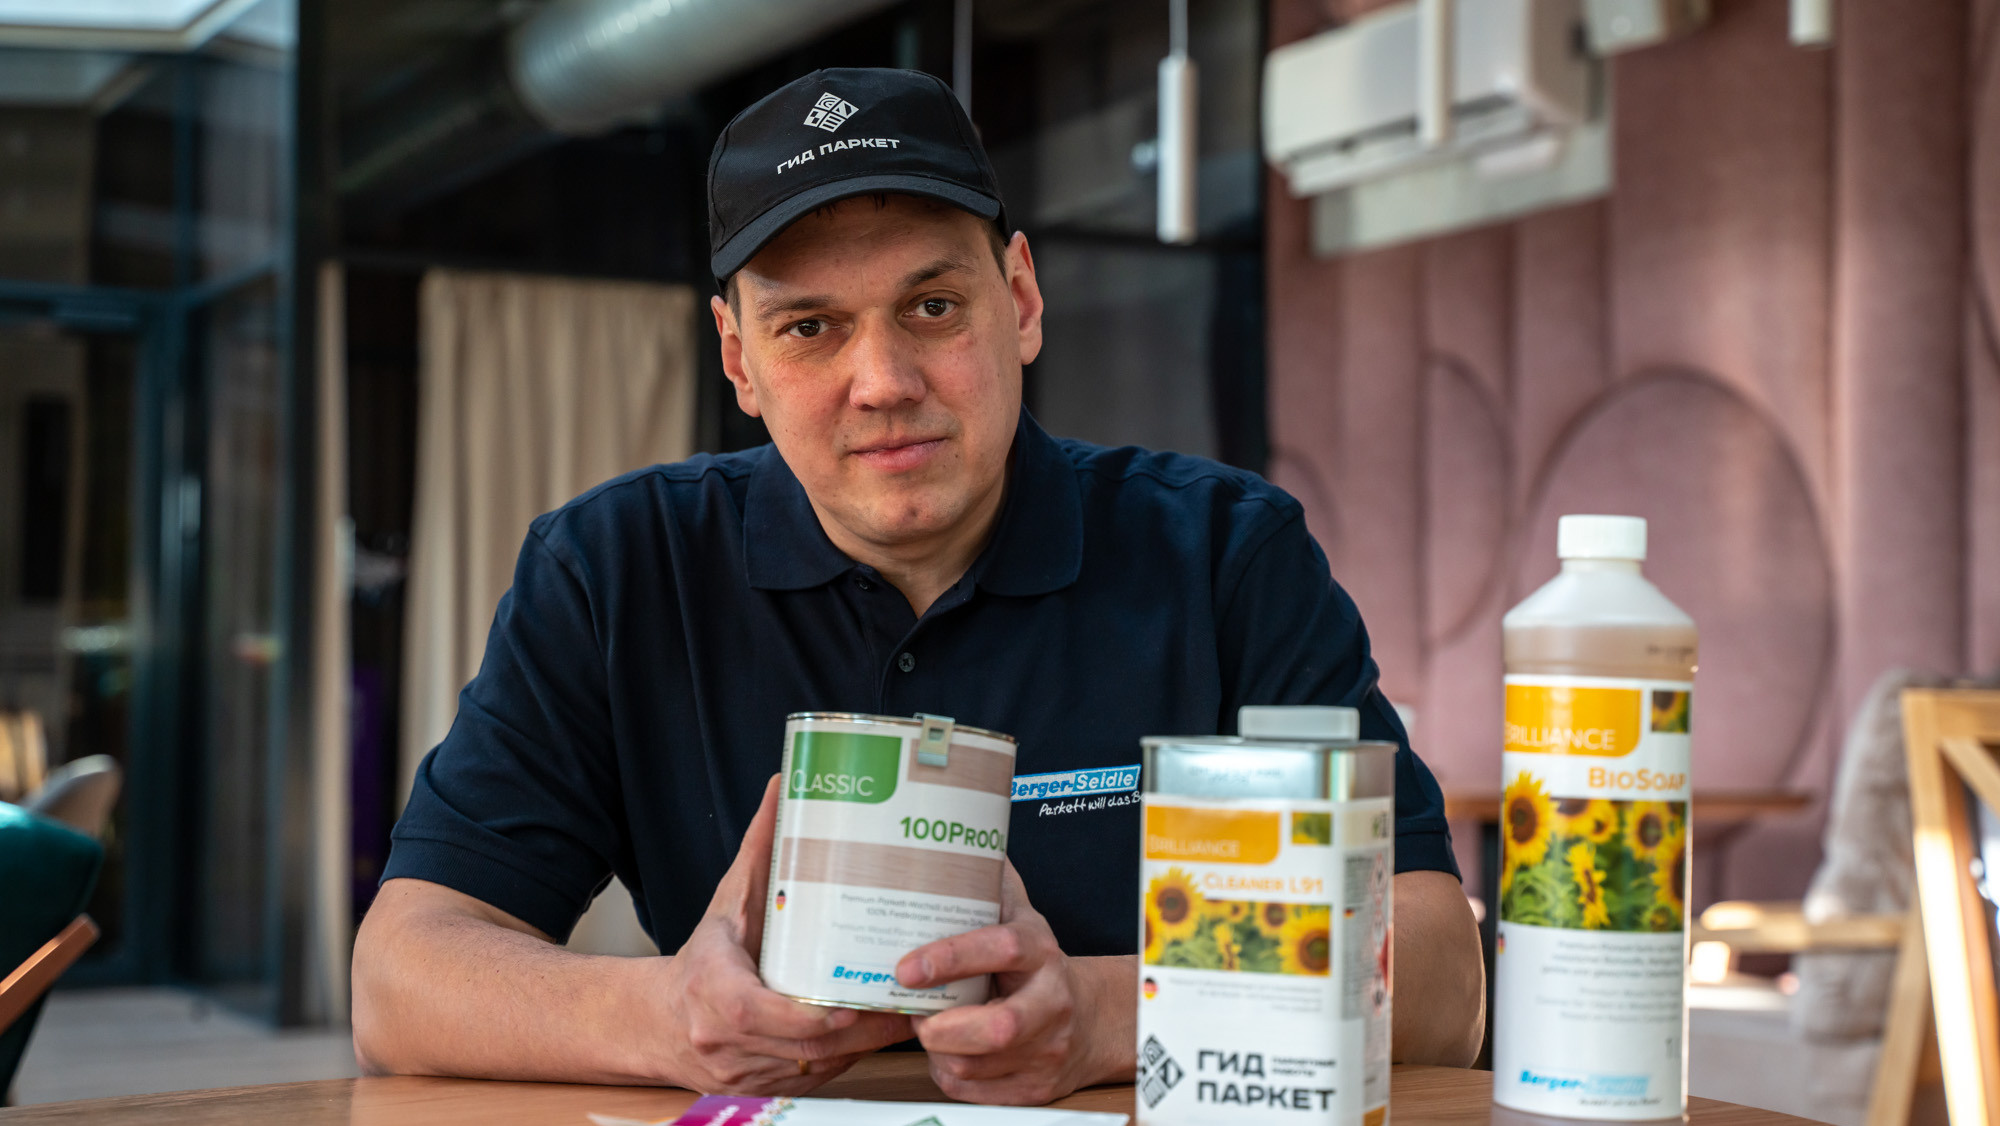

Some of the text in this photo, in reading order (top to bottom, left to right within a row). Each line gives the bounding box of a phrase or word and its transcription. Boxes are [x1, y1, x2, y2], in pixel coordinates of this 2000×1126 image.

[777, 138, 900, 174] ГИД ПАРКЕТ
[1039, 798, 1086, 817] Parkett
[1088, 796, 1106, 811] will
[1107, 795, 1131, 808] das
[1289, 877, 1323, 894] L91
[832, 966, 900, 986] Berger-
[1198, 1050, 1265, 1078] ГИД
[1198, 1081, 1336, 1111] ПАРКЕТ
